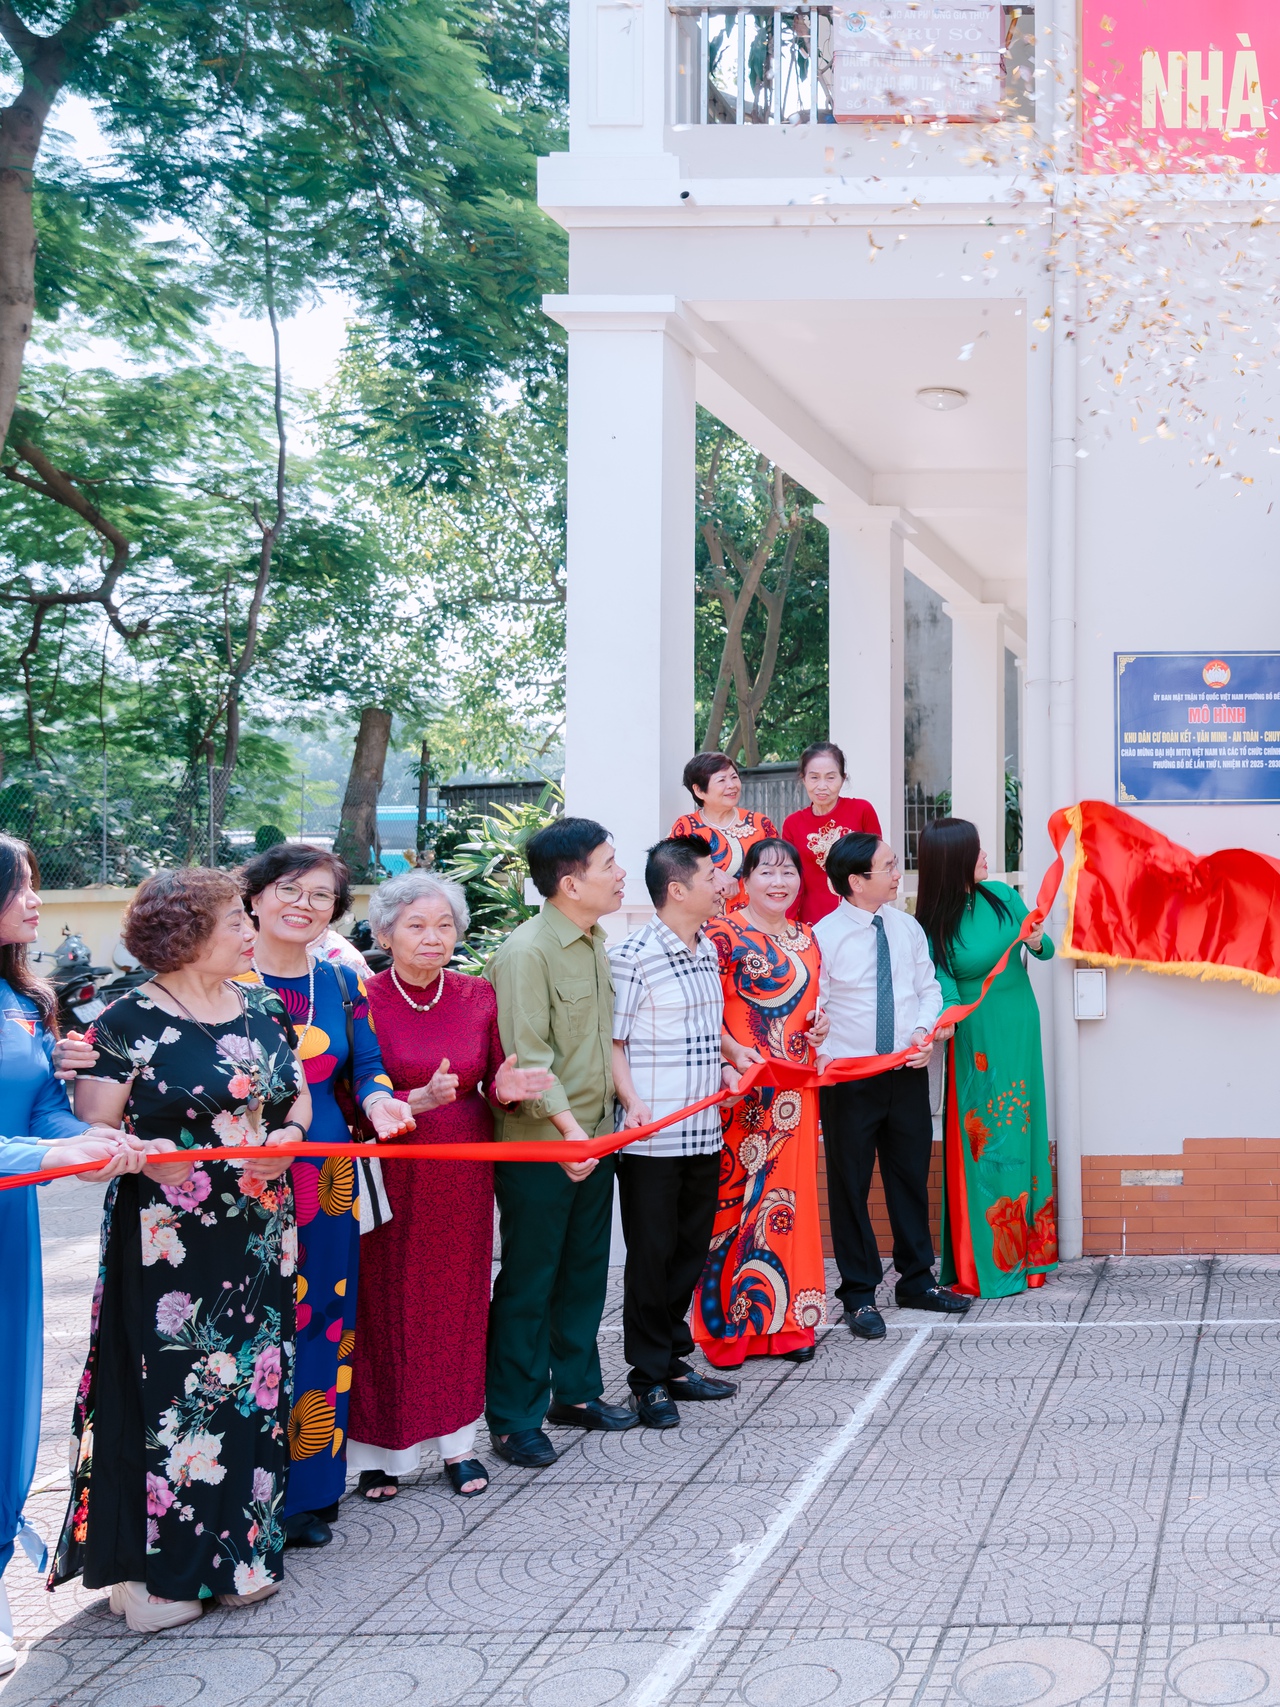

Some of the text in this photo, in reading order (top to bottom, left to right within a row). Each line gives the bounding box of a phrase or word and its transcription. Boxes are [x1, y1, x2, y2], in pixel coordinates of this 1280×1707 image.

[904, 10, 917, 19] AN
[954, 12, 968, 20] GIA
[969, 11, 990, 22] THỤY
[1142, 33, 1265, 128] NHÀ
[1220, 692, 1230, 702] VIỆT
[1188, 703, 1246, 724] MÔ HÌNH
[1124, 732, 1136, 743] KHU
[1138, 730, 1151, 743] DÂN
[1152, 730, 1161, 743] CƯ
[1162, 730, 1179, 743] ĐOÀN
[1180, 728, 1192, 742] KẾT
[1196, 730, 1210, 742] VĂN
[1210, 731, 1228, 742] MINH
[1232, 731, 1242, 742] AN
[1242, 729, 1258, 742] TOÀN
[1120, 746, 1136, 756] CHÀO
[1154, 748, 1164, 758] ĐẠI
[1166, 746, 1176, 758] HỘI
[1176, 748, 1192, 757] MTTQ
[1192, 746, 1204, 758] VIỆT
[1204, 748, 1218, 756] NAM
[1219, 746, 1226, 756] VÀ
[1228, 746, 1238, 756] CÁC
[1264, 746, 1280, 756] CHÍNH
[1194, 758, 1204, 768] LẦN
[1222, 759, 1240, 770] NHIỆM
[1250, 760, 1264, 768] 2025
